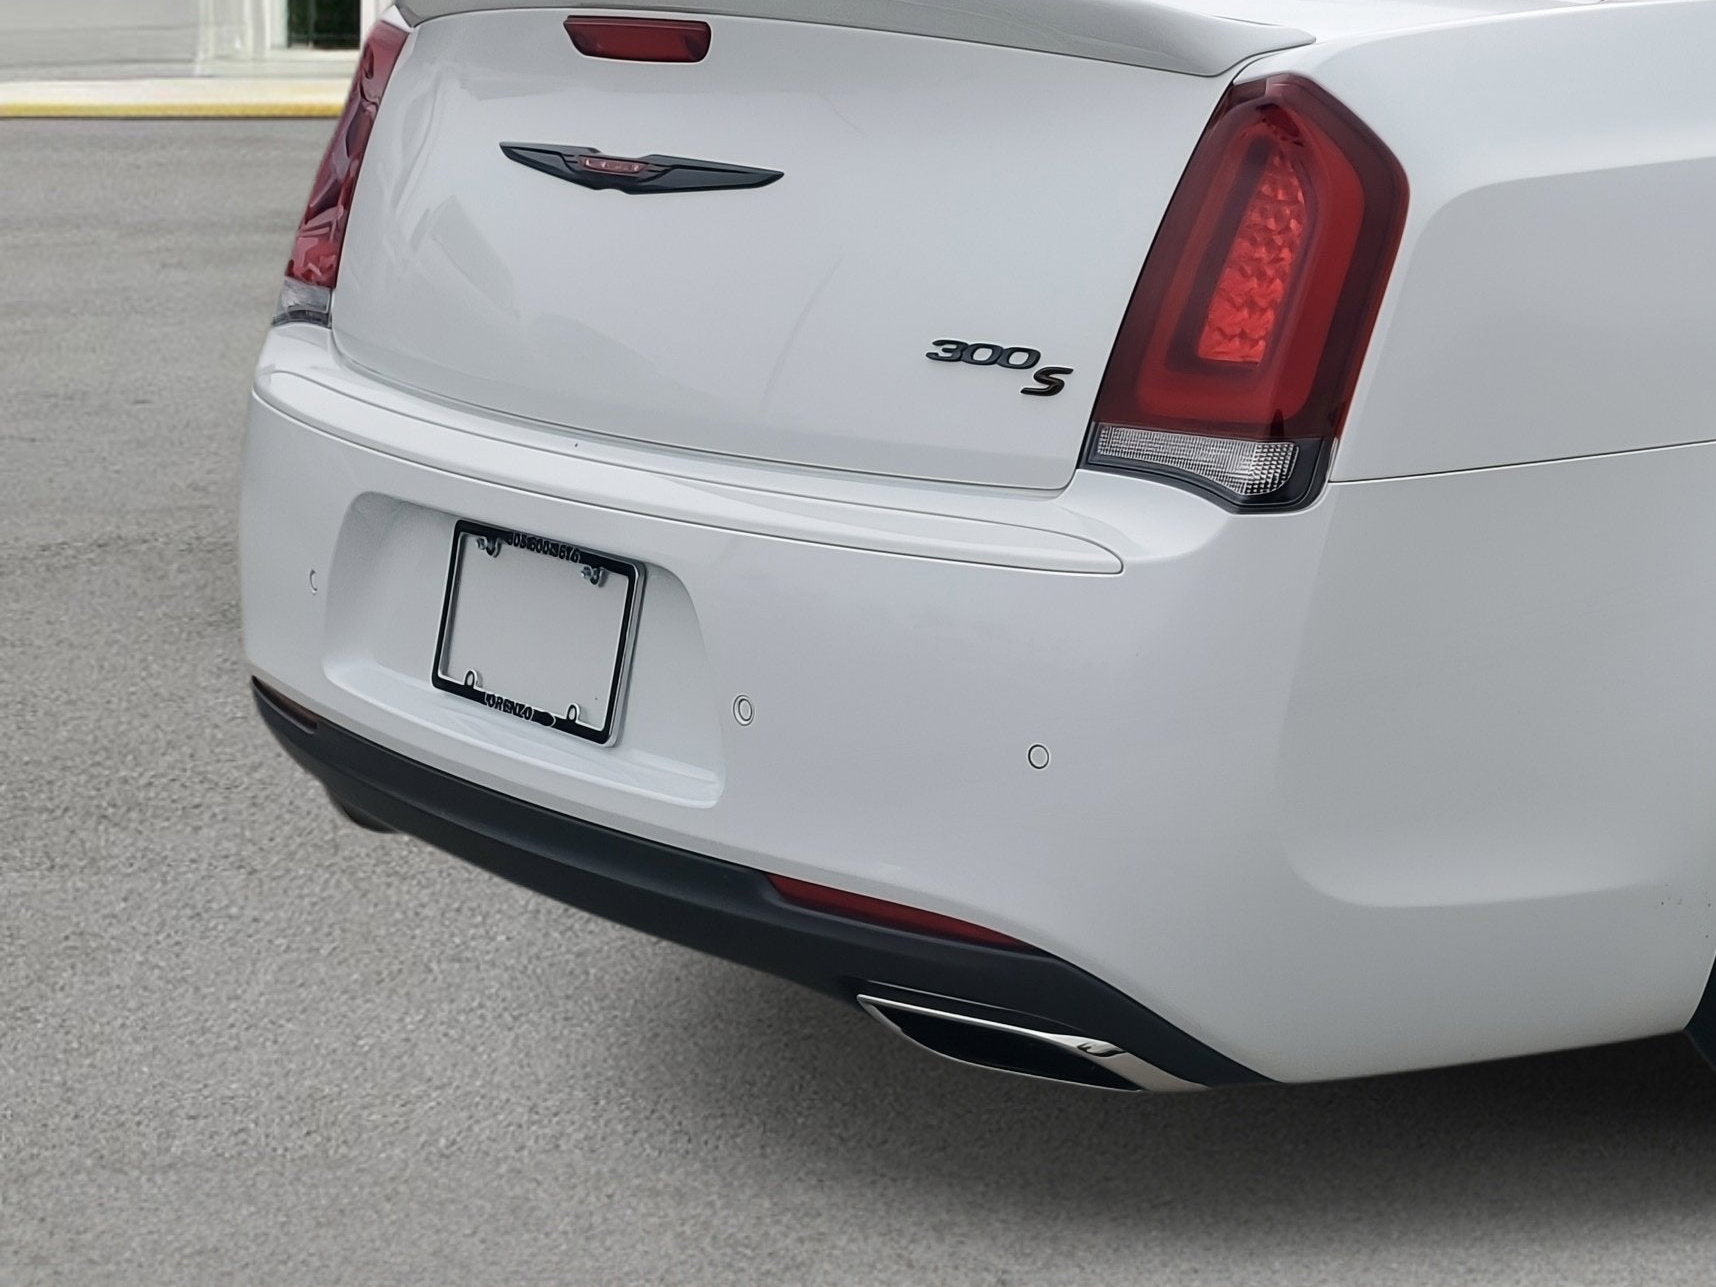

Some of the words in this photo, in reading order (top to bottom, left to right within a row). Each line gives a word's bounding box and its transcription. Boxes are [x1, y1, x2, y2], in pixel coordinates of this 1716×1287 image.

[925, 339, 1042, 370] 300
[1020, 366, 1075, 397] S
[485, 691, 534, 722] LORENZO
